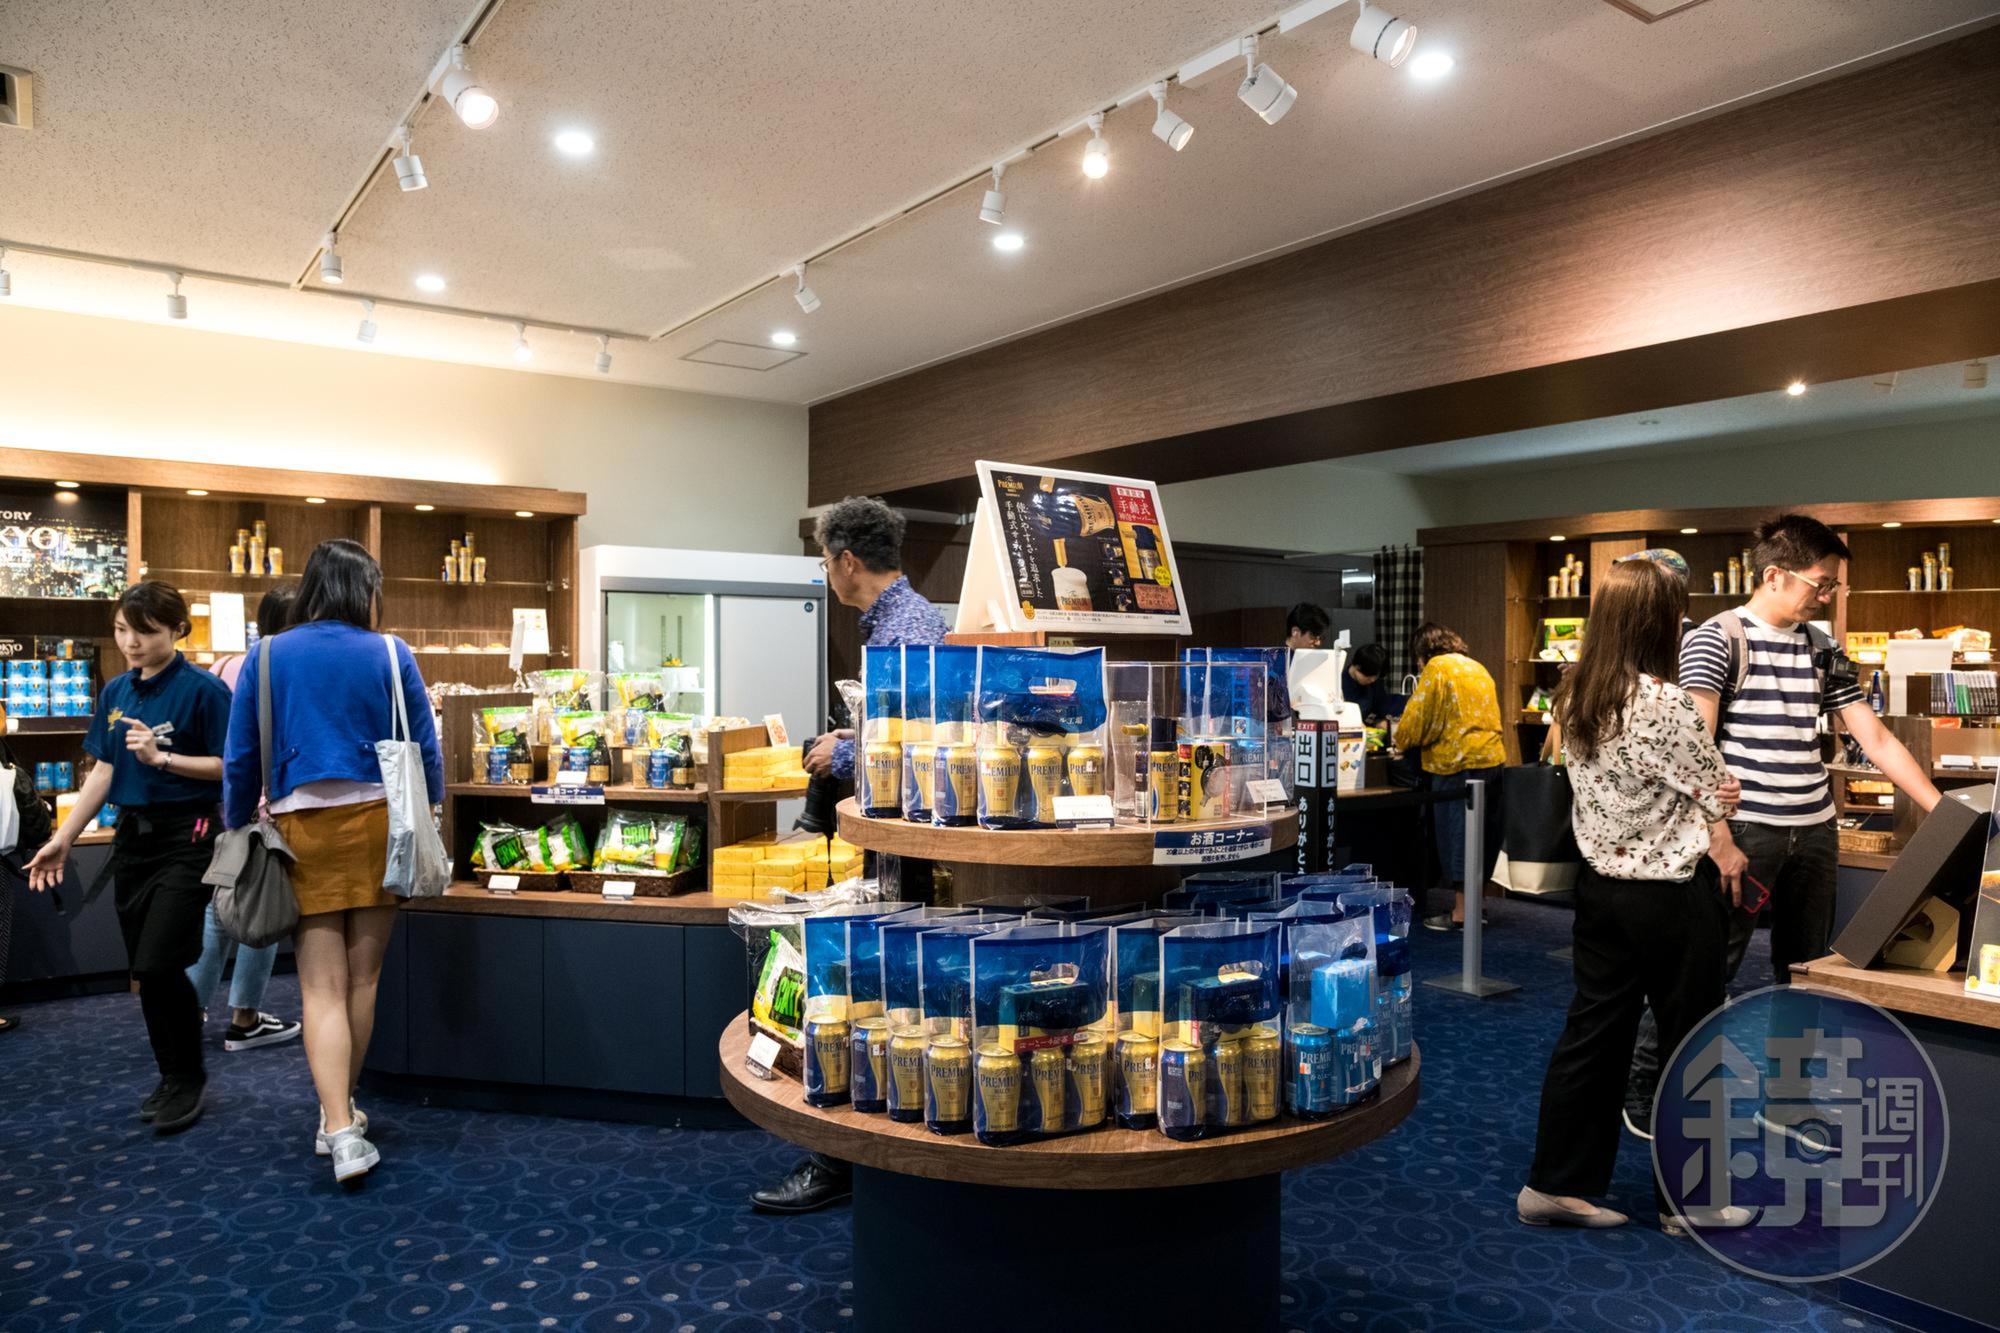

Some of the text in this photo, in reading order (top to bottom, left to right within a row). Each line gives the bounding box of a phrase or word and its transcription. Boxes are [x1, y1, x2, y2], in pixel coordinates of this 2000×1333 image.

[1298, 734, 1312, 784] 出口
[1325, 735, 1336, 784] 出口
[1190, 829, 1254, 846] お酒コーナー
[1327, 798, 1335, 872] ありがと
